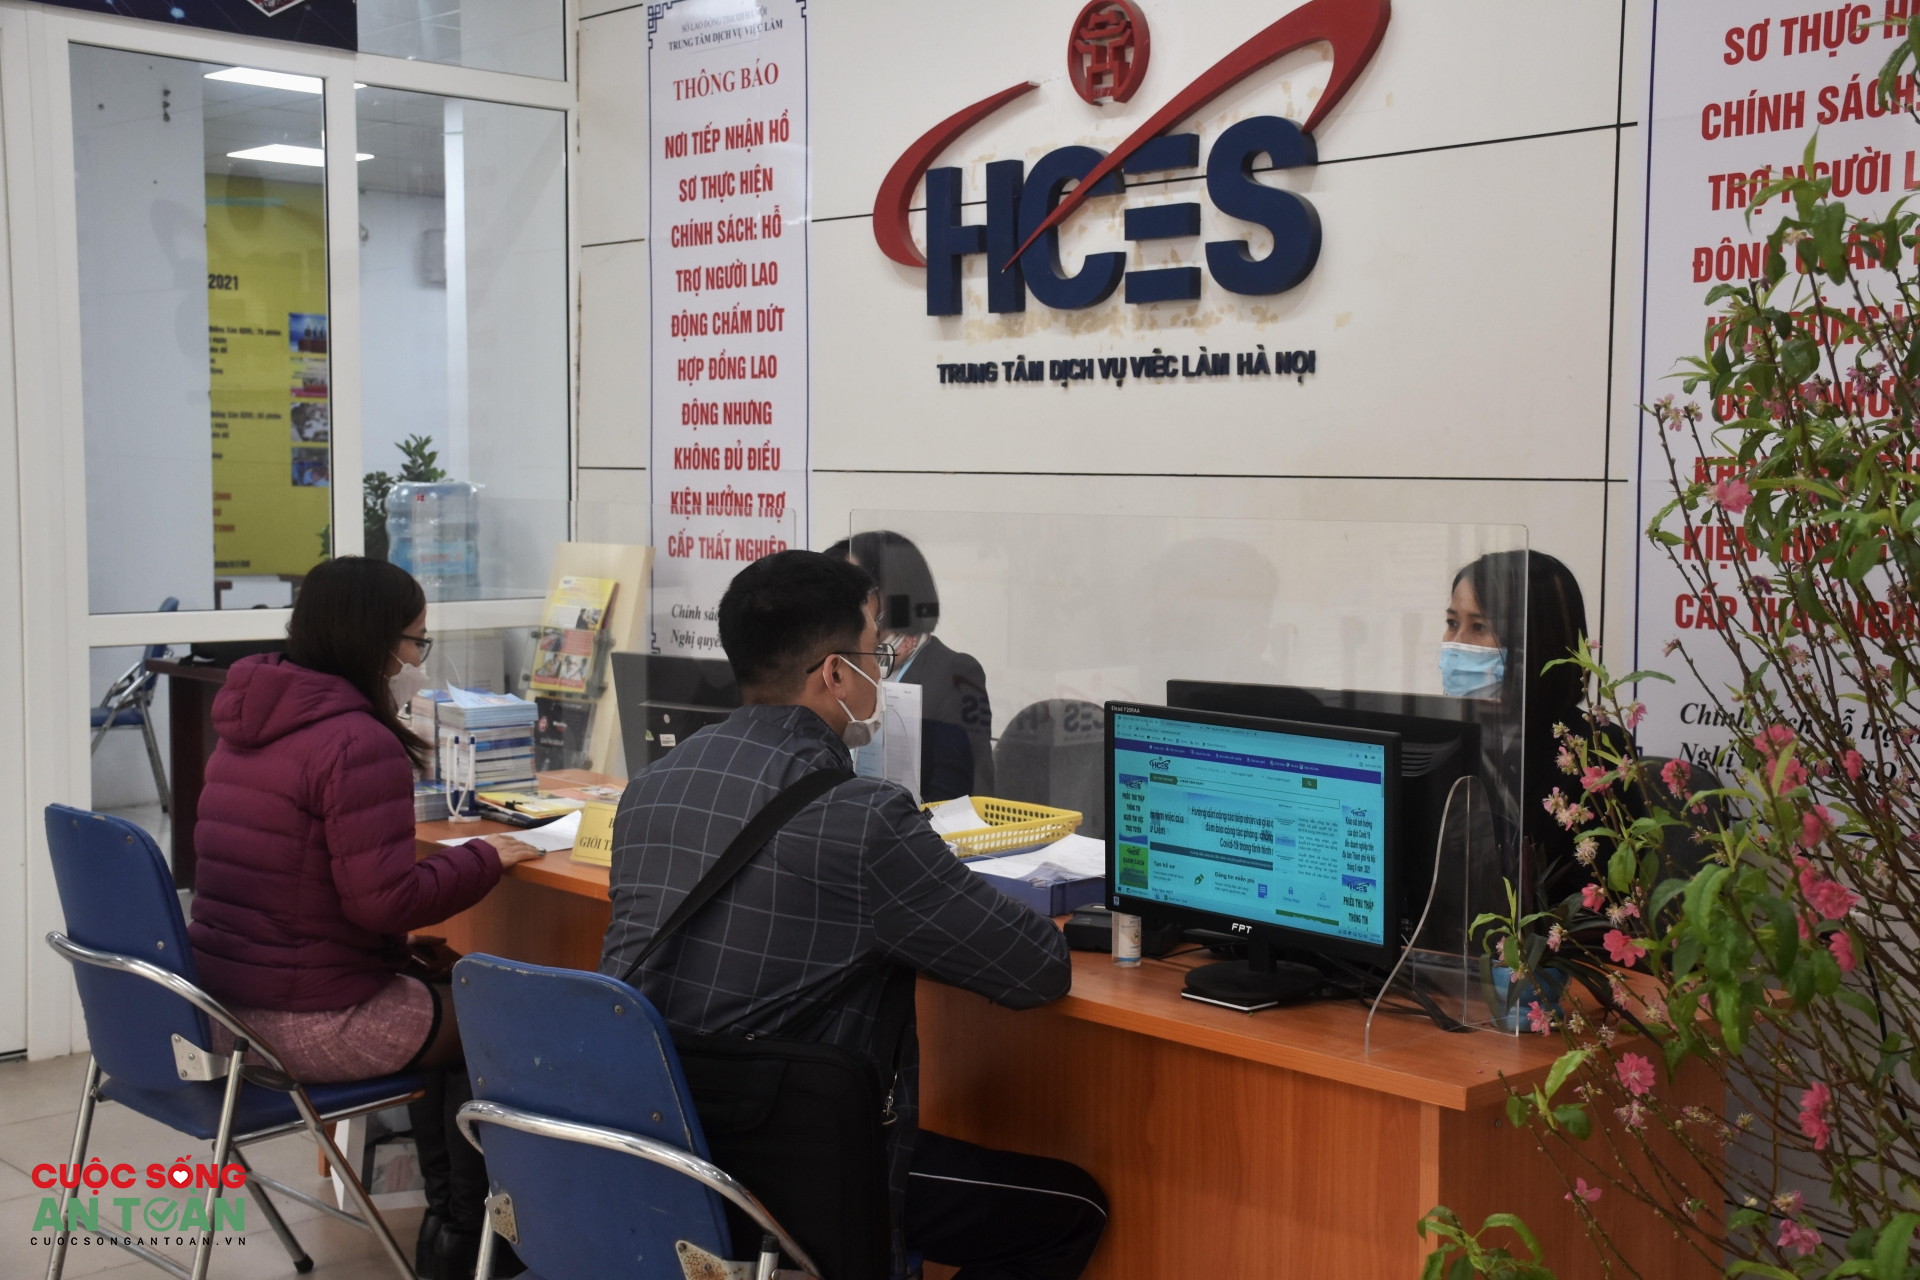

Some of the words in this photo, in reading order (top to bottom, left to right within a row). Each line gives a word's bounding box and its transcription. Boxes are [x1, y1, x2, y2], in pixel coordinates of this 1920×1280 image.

[668, 37, 694, 51] TRUNG
[695, 32, 711, 46] TÂM
[712, 29, 732, 43] DỊCH
[733, 27, 744, 39] VỤ
[764, 18, 783, 32] LÀM
[1723, 18, 1770, 65] SƠ
[1780, 2, 1871, 58] THỰC
[673, 68, 735, 101] THÔNG
[740, 58, 779, 89] BÁO
[1701, 89, 1805, 141] CHÍNH
[665, 133, 688, 159] NƠI
[691, 121, 721, 155] TIẾP
[725, 118, 764, 153] NHẬN
[679, 175, 697, 203] SƠ
[701, 171, 735, 203] THỰC
[740, 163, 774, 199] HIỆN
[1708, 165, 1772, 215] TRỢ
[671, 218, 713, 249] CHÍNH
[717, 214, 758, 244] SÁCH:
[762, 204, 782, 239] HỖ
[925, 115, 1322, 317] HCES
[208, 273, 239, 290] 2021
[676, 265, 702, 297] TRỢ
[705, 258, 747, 290] NGƯỜI
[752, 261, 778, 287] LAO
[671, 309, 708, 342] ĐỘNG
[712, 302, 751, 336] CHẤM
[757, 305, 785, 333] DỨT
[678, 356, 704, 386] HỢP
[709, 349, 746, 380] ĐỒNG
[751, 355, 778, 379] LAO
[936, 361, 998, 384] TRUNG
[1002, 354, 1044, 381] TÂM
[1049, 357, 1094, 389] DỊCH
[1098, 356, 1126, 387] VỤ
[1182, 346, 1230, 377] LÀM
[1237, 344, 1271, 376] HÀ
[682, 398, 719, 430] ĐỘNG
[723, 399, 773, 425] NHƯNG
[674, 442, 720, 470] KHÔNG
[724, 439, 743, 470] ĐỦ
[747, 439, 781, 470] ĐIỀU
[670, 487, 702, 520] KIỆN
[706, 485, 753, 516] HƯỞNG
[758, 491, 786, 522] TRỢ
[668, 527, 695, 558] CẤP
[699, 529, 732, 560] THẤT
[671, 603, 701, 620] Chính
[1675, 582, 1738, 630] CẤP
[670, 629, 696, 649] Nghị
[1231, 922, 1252, 934] FPT
